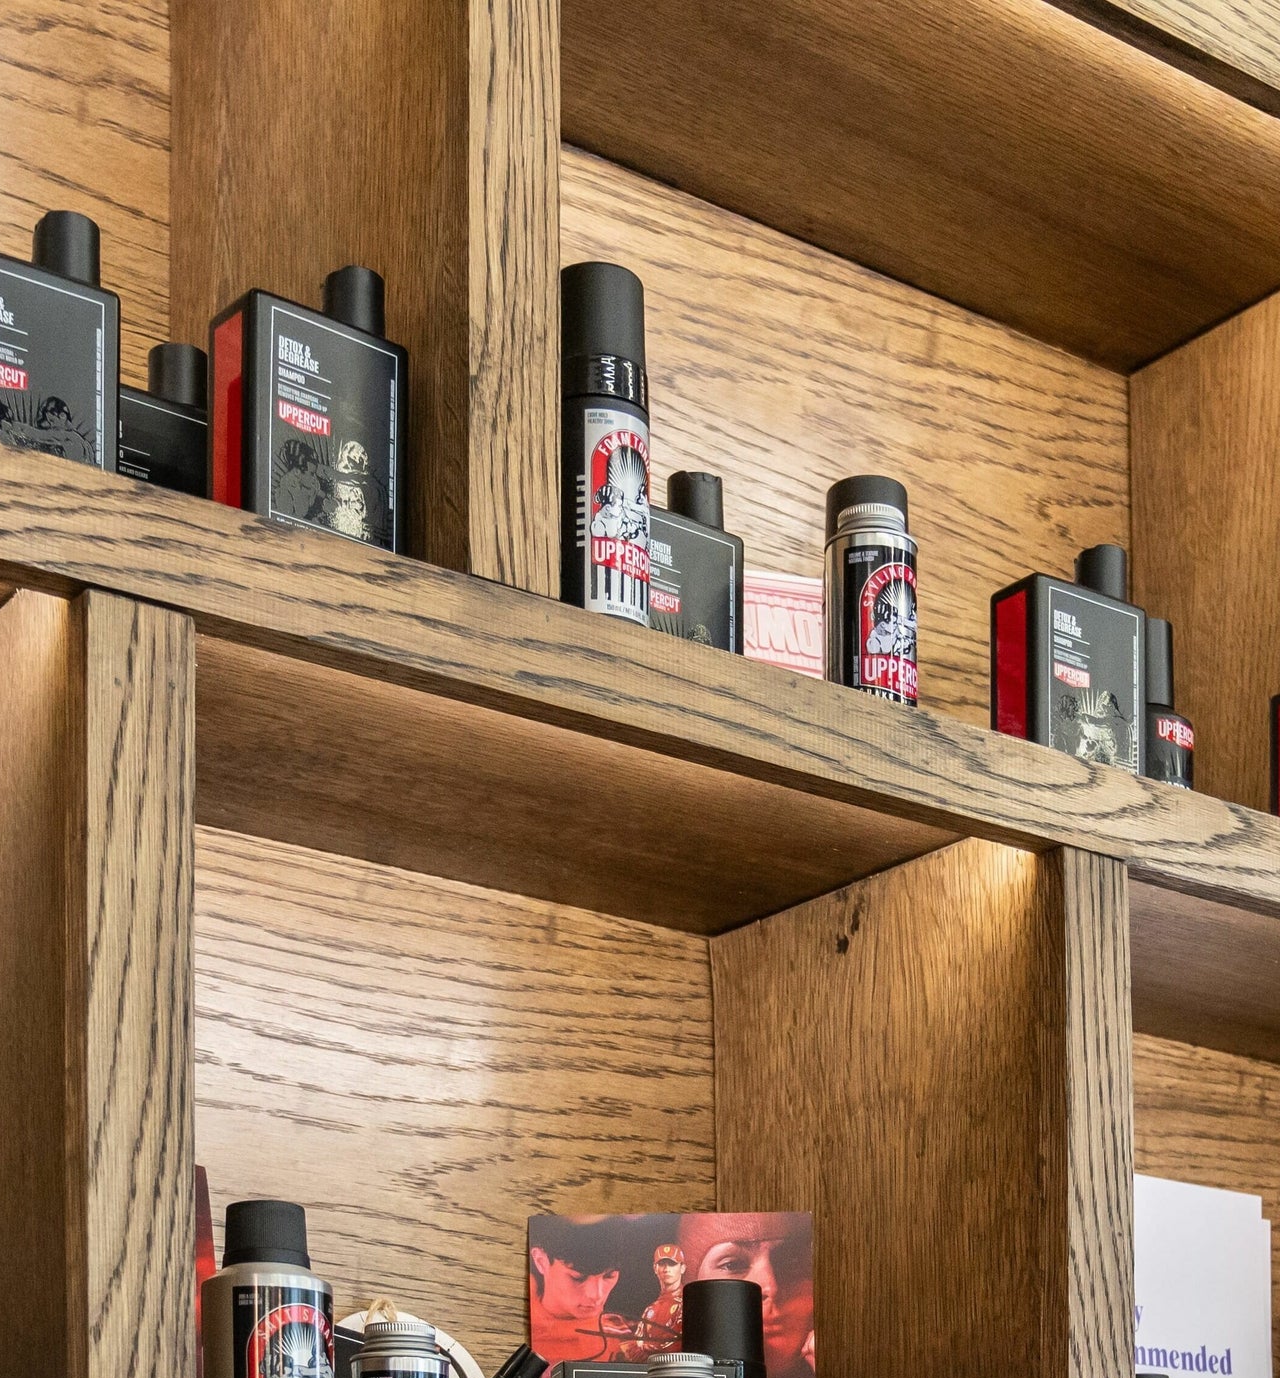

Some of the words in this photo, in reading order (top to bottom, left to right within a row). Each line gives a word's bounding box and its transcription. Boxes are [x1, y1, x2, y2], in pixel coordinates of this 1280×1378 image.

[278, 335, 304, 356] DETOX
[304, 345, 311, 358] &
[279, 347, 319, 374] DEGREASE
[278, 366, 305, 385] SHAMPOO
[278, 402, 328, 436] UPPERCUT
[598, 432, 629, 456] FOAM
[863, 565, 904, 608] STYLING
[1053, 619, 1083, 639] DEGREASE
[1054, 662, 1090, 688] UPPERCUT
